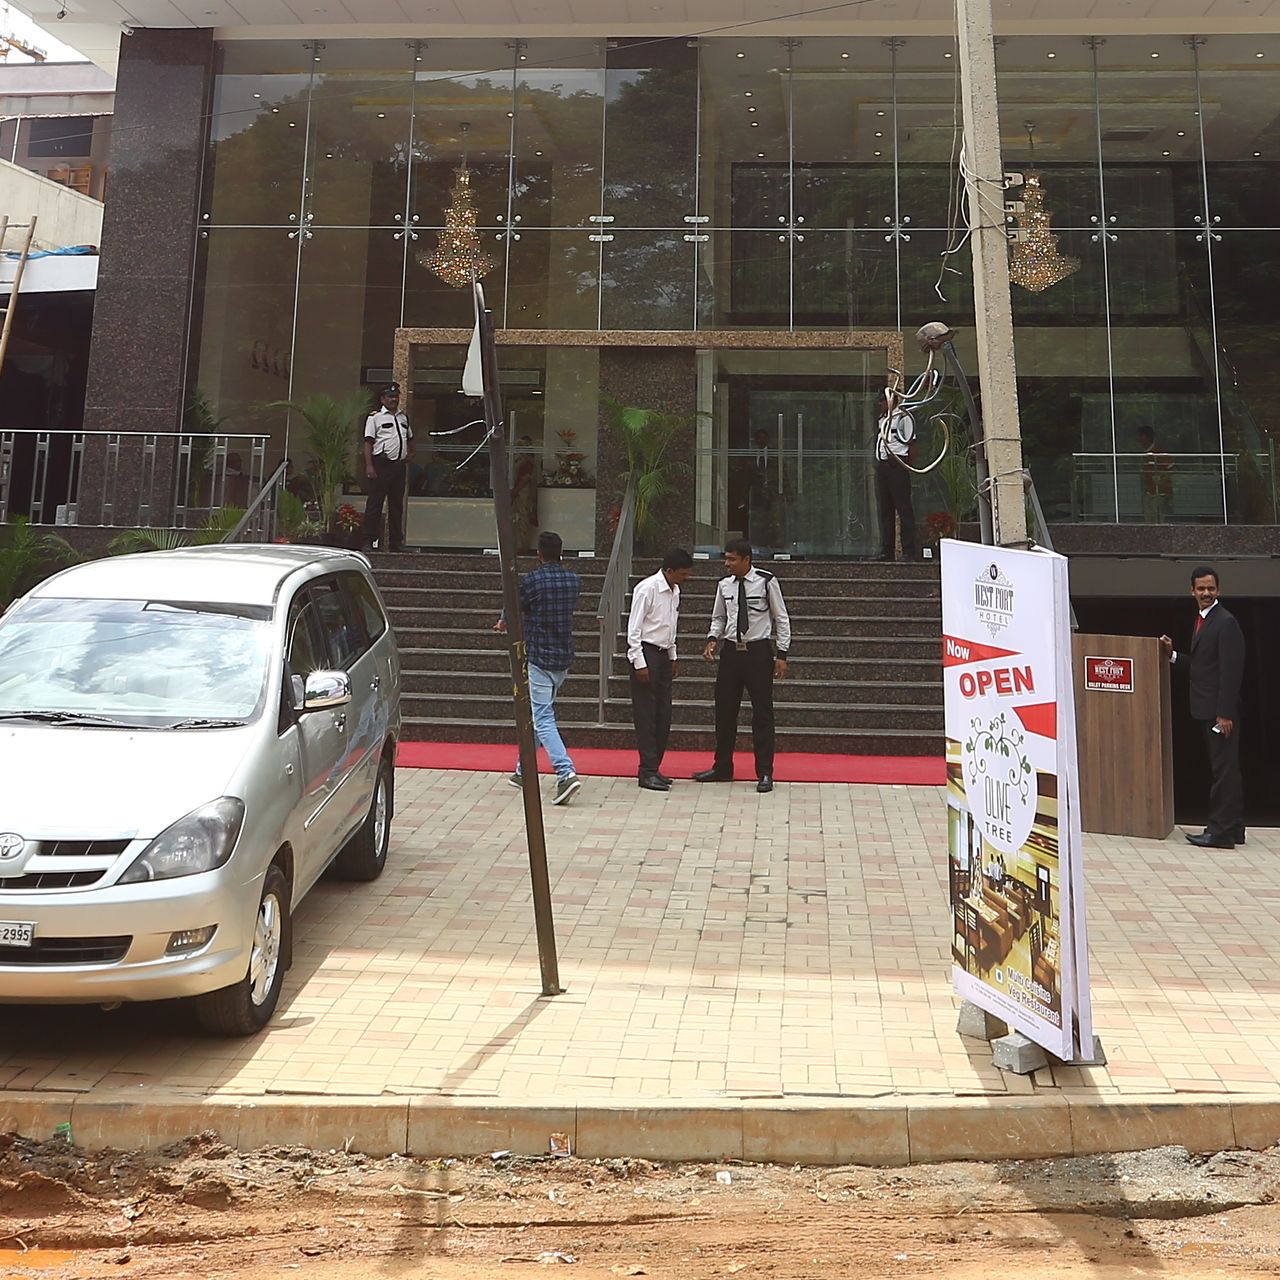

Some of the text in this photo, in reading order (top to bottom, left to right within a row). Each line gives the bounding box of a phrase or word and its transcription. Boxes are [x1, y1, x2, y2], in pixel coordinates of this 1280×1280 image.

[974, 583, 1014, 612] WEST FORT
[979, 611, 1009, 625] HOTEL
[959, 665, 1035, 699] OPEN
[984, 775, 1012, 826] OLIVE
[984, 821, 1012, 844] TREE
[1007, 983, 1021, 1003] Veg
[1021, 991, 1060, 1025] Restaurant
[1024, 976, 1053, 1004] Cuisine
